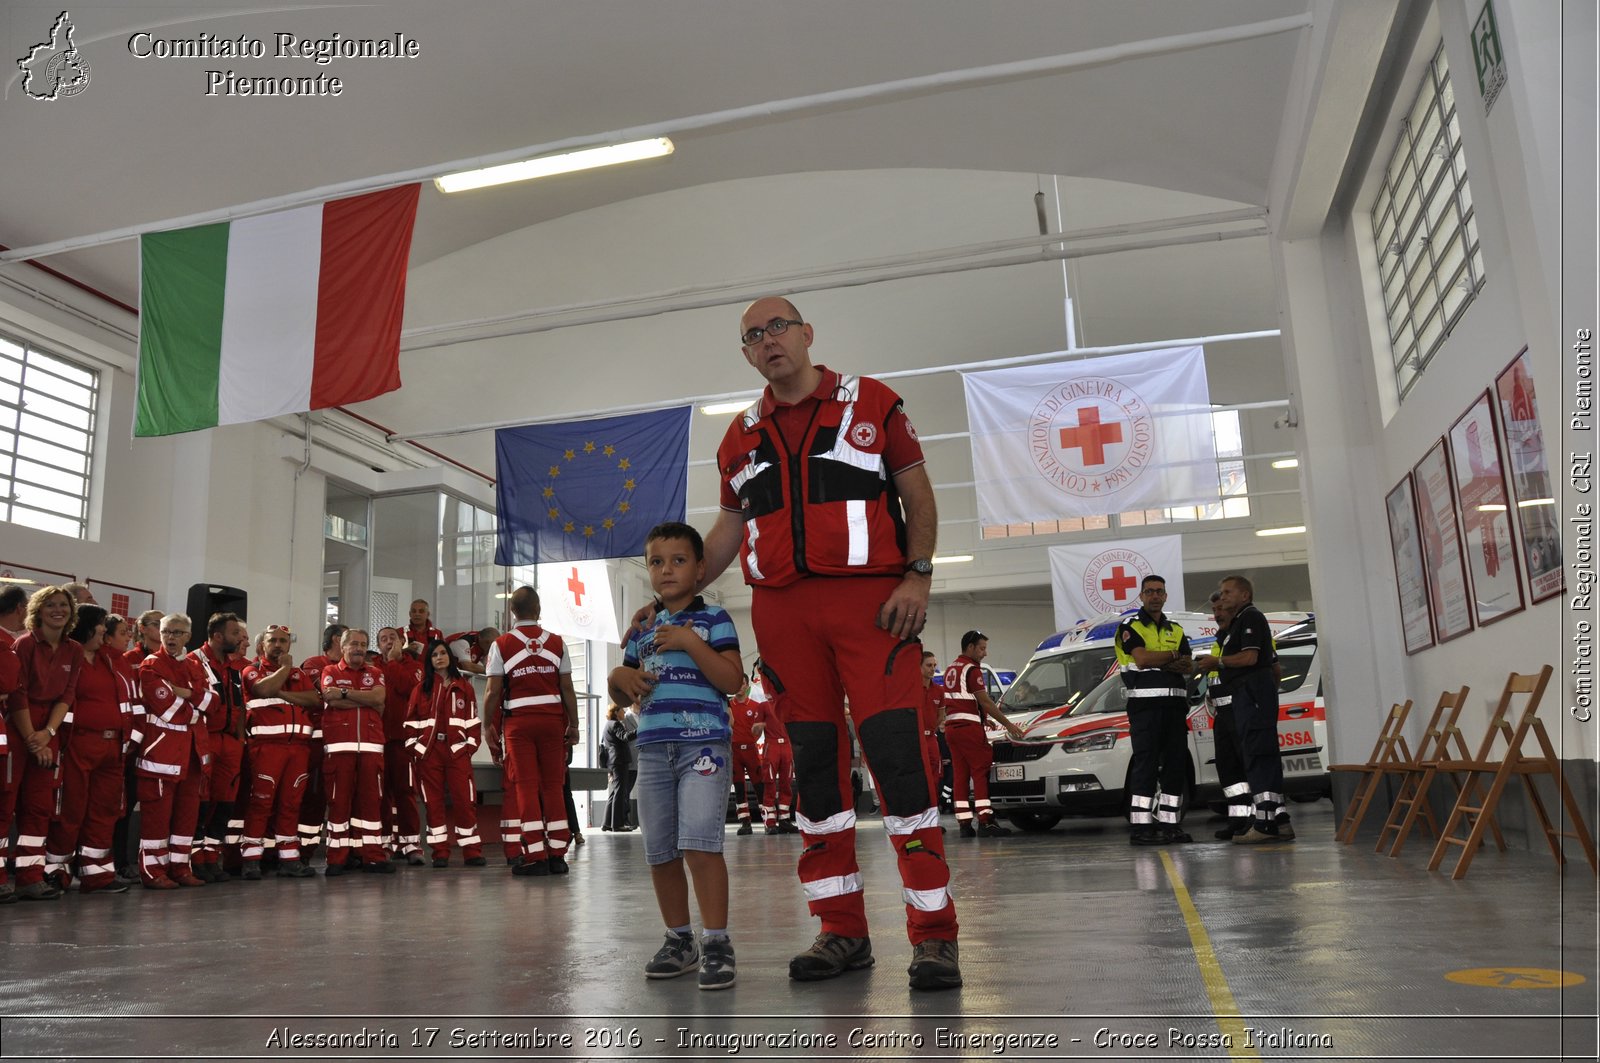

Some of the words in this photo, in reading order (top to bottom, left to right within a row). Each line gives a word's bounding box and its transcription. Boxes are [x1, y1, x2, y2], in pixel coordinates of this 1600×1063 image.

[1061, 380, 1122, 402] GINEVRA
[1045, 394, 1063, 412] DI
[1123, 398, 1141, 415] 22
[1032, 411, 1087, 492] CONVENZIONE
[1131, 413, 1150, 469] AGOSTO
[1104, 467, 1133, 490] 1864
[1279, 730, 1313, 747] OSSA
